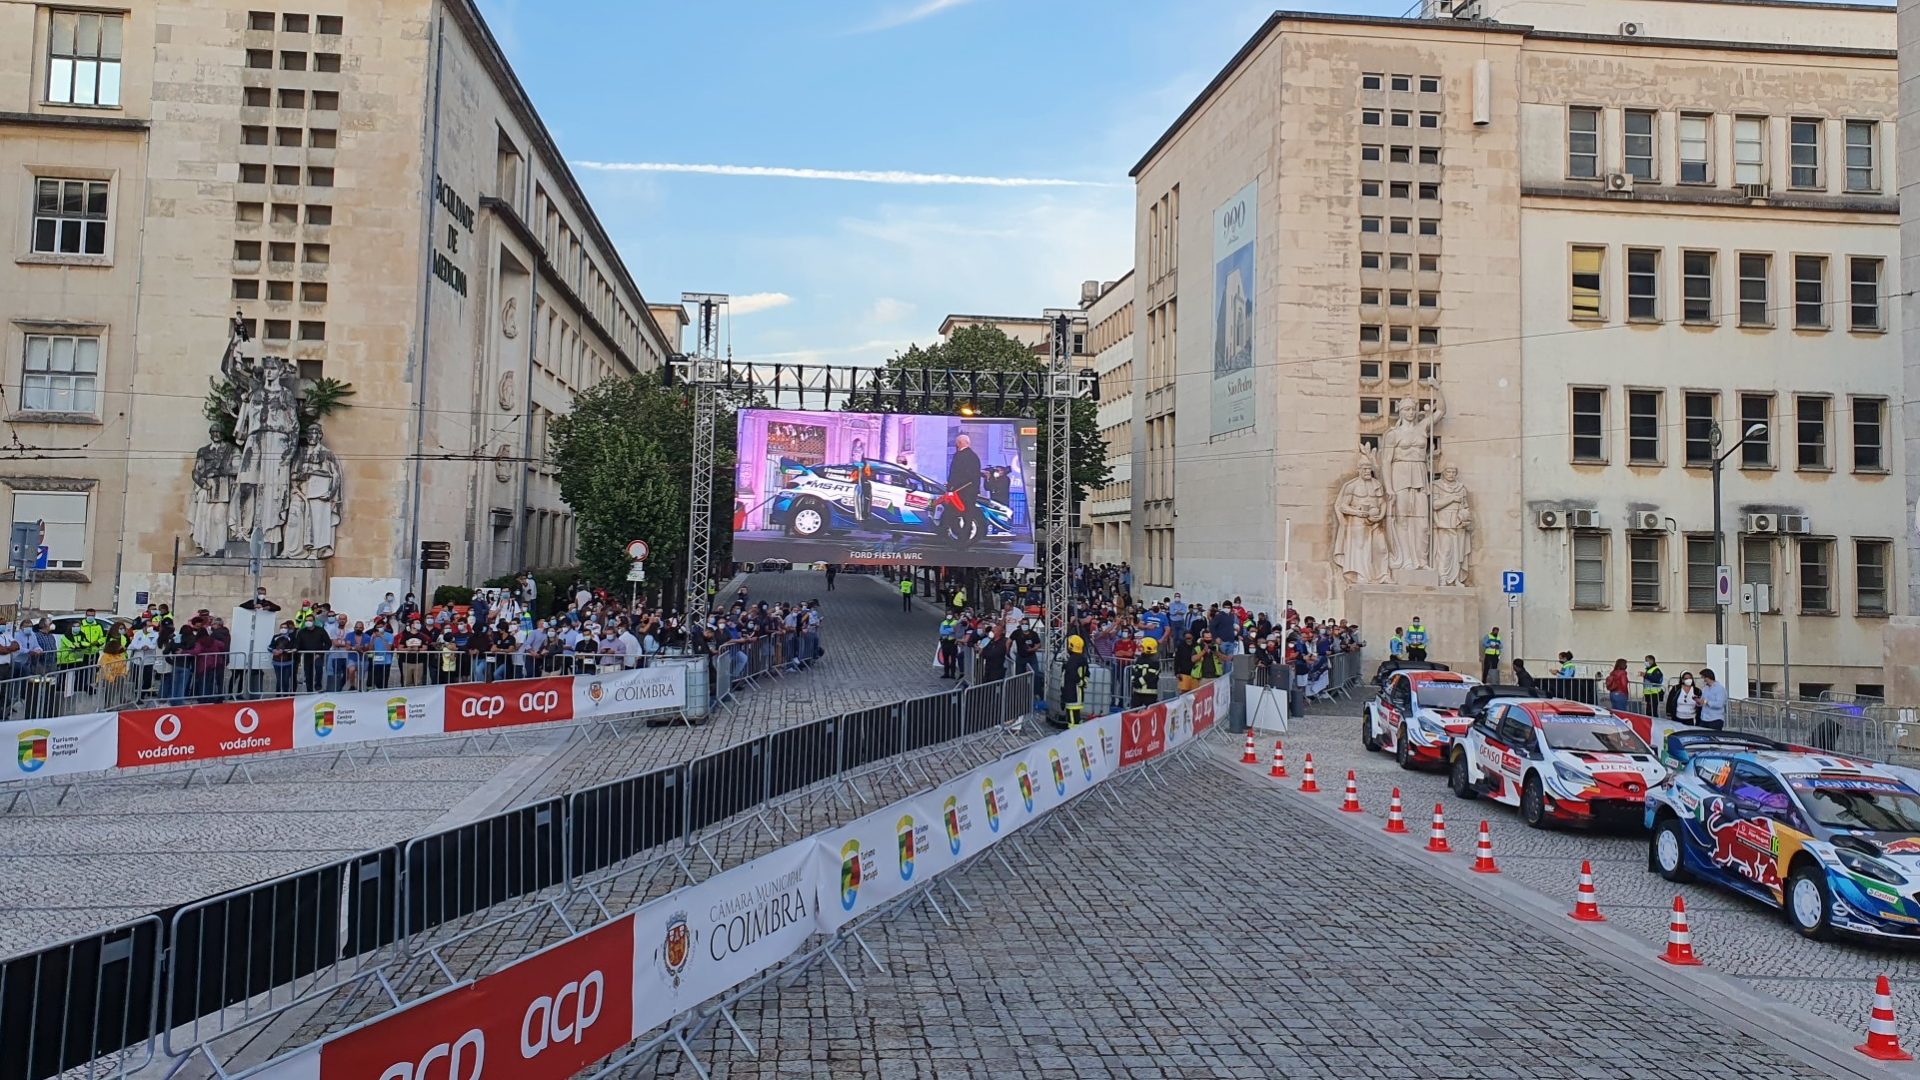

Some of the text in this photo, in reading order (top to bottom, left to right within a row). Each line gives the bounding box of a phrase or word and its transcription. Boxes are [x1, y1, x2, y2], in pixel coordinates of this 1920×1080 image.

[447, 223, 459, 254] DE
[433, 247, 467, 298] MEDICINA
[850, 551, 923, 560] FORD FIESTA WRC
[1507, 573, 1520, 591] P
[519, 689, 559, 714] acp
[615, 683, 675, 702] COIMBRA
[461, 695, 505, 719] acp
[52, 736, 79, 744] Turismo
[219, 736, 271, 751] vodafone
[51, 748, 78, 757] Portugal
[137, 744, 195, 760] vodafone
[1480, 744, 1500, 765] DENSO
[1601, 764, 1645, 773] DENSO
[1814, 780, 1900, 792] AsahiKASEI
[709, 868, 804, 922] CÂMARA MUNICIPAL
[1873, 889, 1896, 903] Castrol
[710, 887, 807, 961] COIMBRA
[520, 970, 604, 1059] acp
[379, 1028, 486, 1080] cp
